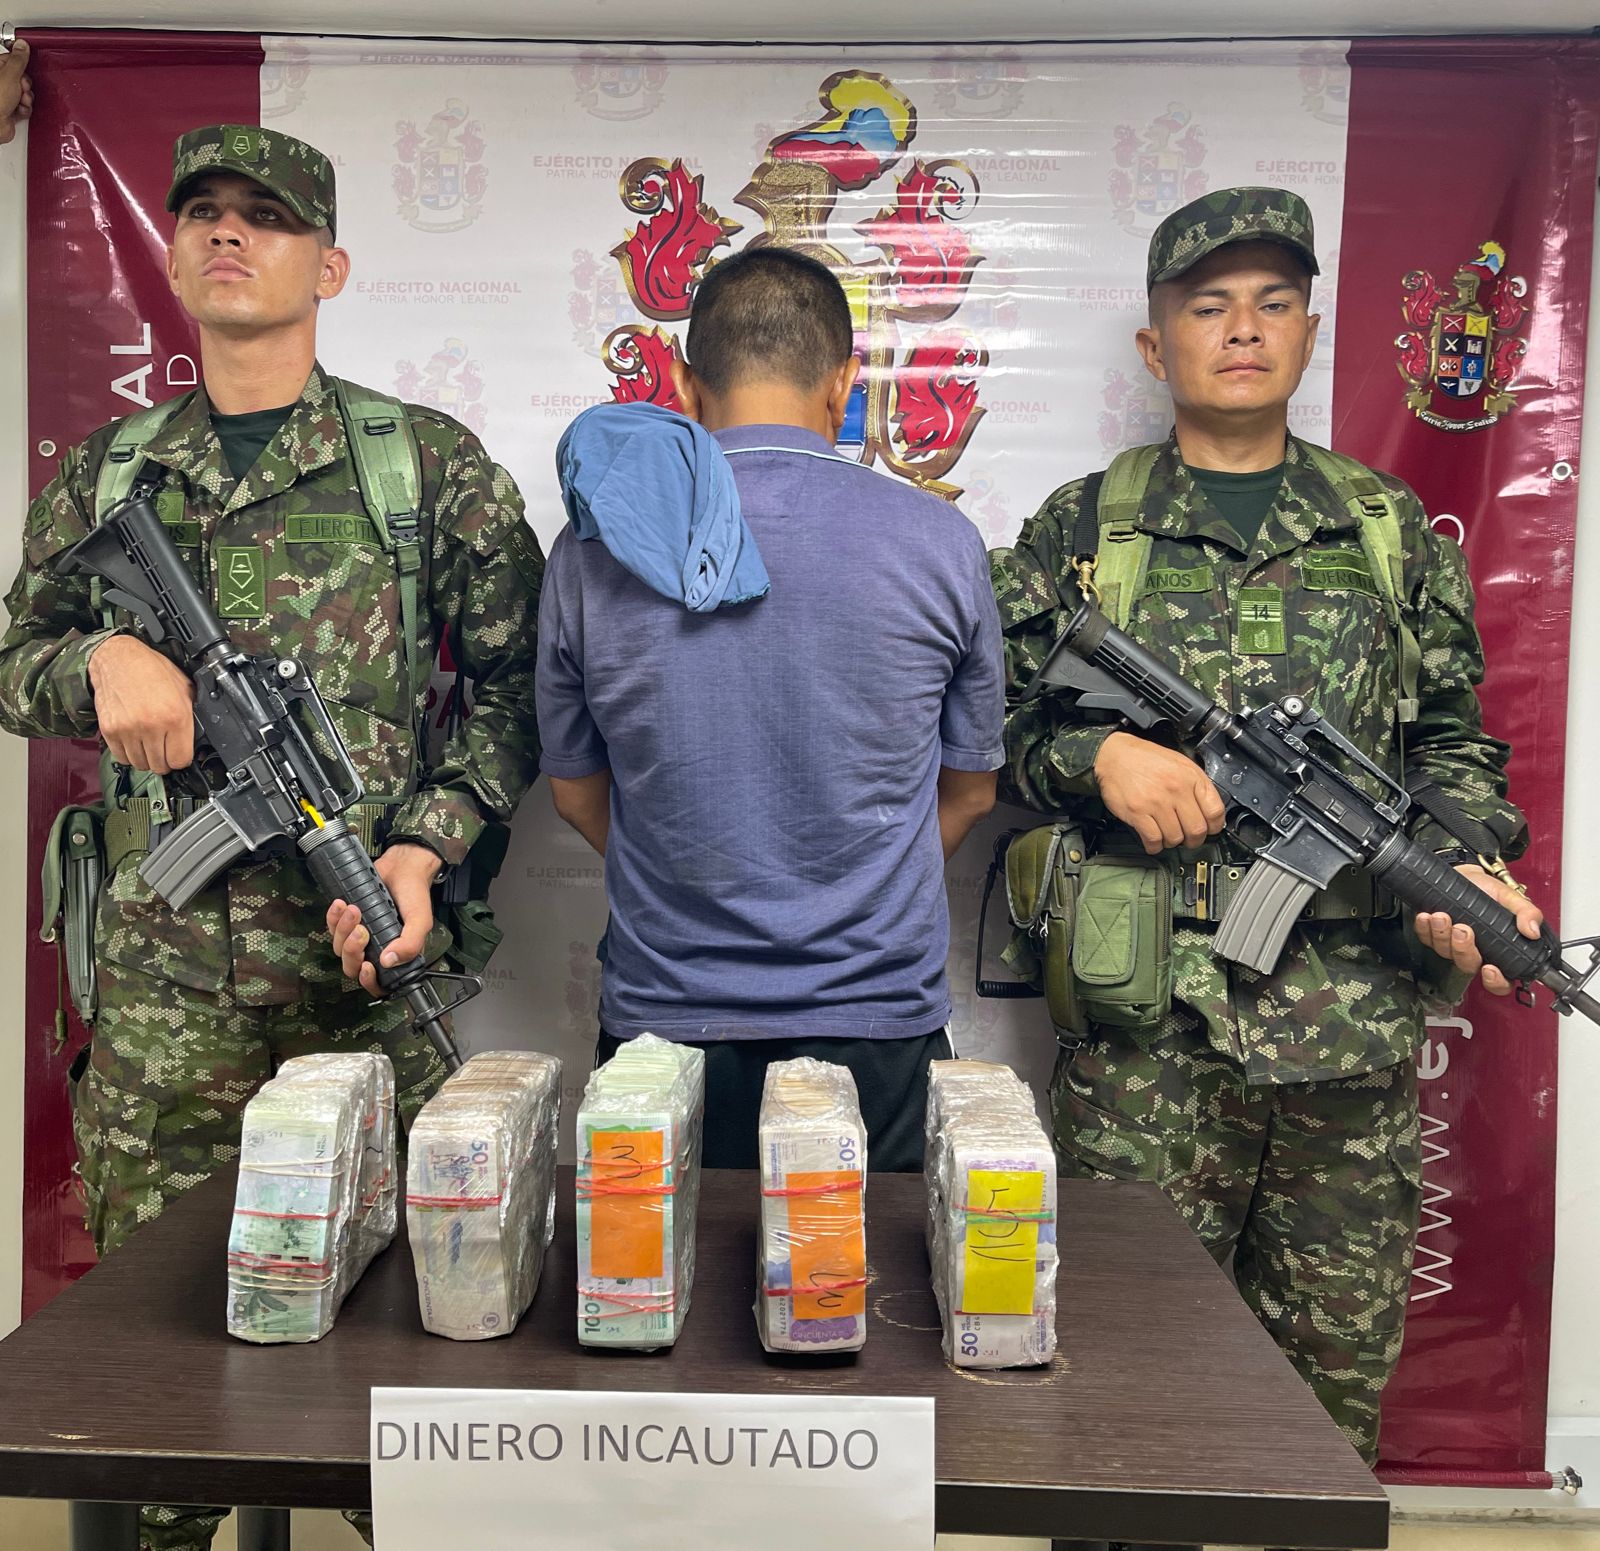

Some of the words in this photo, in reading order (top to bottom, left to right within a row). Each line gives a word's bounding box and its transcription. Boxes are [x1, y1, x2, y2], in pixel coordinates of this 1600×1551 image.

[976, 159, 1061, 171] NACIONAL
[546, 169, 586, 179] PATRIA
[998, 172, 1047, 182] LEALTAD
[1268, 174, 1308, 184] PATRIA
[440, 281, 522, 293] NACIONAL
[368, 294, 408, 304] PATRIA
[414, 294, 454, 304] HONOR
[461, 294, 509, 304] LEALTAD
[1079, 301, 1119, 311] PATRIA
[1253, 604, 1269, 620] 14
[471, 1140, 489, 1165] 50
[839, 1136, 856, 1162] 50
[605, 1145, 642, 1178] 3
[584, 1302, 600, 1334] 100
[961, 1332, 978, 1357] 50
[376, 1422, 563, 1462] DINERO
[583, 1424, 879, 1470] INCAUTADO
